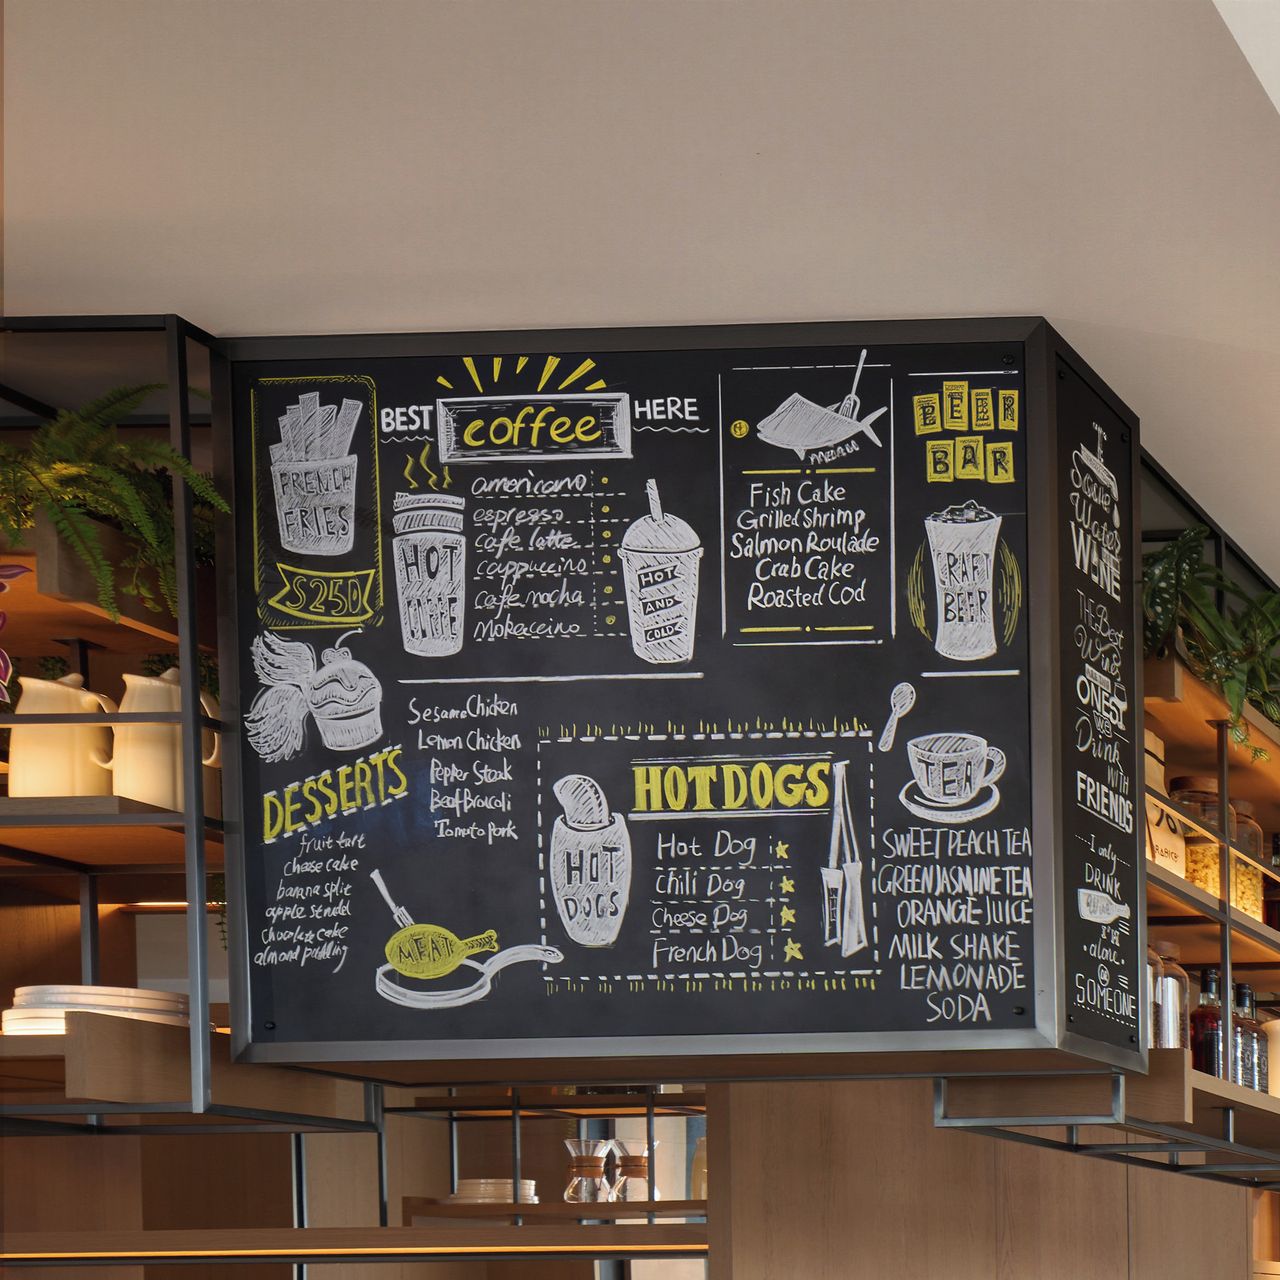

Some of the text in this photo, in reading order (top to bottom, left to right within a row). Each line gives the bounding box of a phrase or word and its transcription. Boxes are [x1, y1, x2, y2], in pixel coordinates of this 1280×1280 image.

[380, 397, 699, 447] BEST coffee HERE
[931, 445, 1010, 476] BAR
[471, 469, 587, 495] americano
[750, 478, 846, 507] Fish Cake
[283, 505, 350, 540] FRIES
[473, 507, 564, 533] espresso
[736, 506, 866, 534] Grilled Shrimp
[730, 528, 880, 559] Salmon Roulade
[402, 544, 458, 582] HOT
[640, 567, 674, 586] HOT
[755, 554, 855, 581] Crab Cake
[937, 552, 990, 587] CRAFT
[645, 598, 674, 614] AND
[747, 578, 867, 611] Roasted Cod
[944, 590, 990, 623] BEER
[646, 625, 675, 641] COLD
[408, 693, 518, 725] Sesame Chicken
[418, 728, 522, 752] Lemon Chicken
[430, 757, 469, 786] Pepper
[632, 762, 830, 811] HOT DOGS
[917, 758, 974, 798] TEA
[263, 750, 407, 840] DESSERTS
[1077, 770, 1133, 834] FRIENDS
[299, 834, 333, 857] fruit
[658, 830, 756, 866] Hot Dog
[882, 826, 1032, 859] SWEET PEACH TEA
[565, 845, 621, 886] HOT
[878, 863, 1033, 899] GREEN JASMINE TEA
[1085, 862, 1122, 900] DRINK
[656, 869, 745, 899] Chili Dog
[652, 904, 748, 929] Cheese Dog
[897, 897, 1033, 929] ORANGE JUICE
[399, 936, 454, 965] MEAT
[653, 935, 762, 969] French Dog
[888, 931, 1020, 961] MILK SHAKE
[900, 962, 1026, 993] LEMONADE
[926, 992, 992, 1023] SODA
[1076, 973, 1136, 1019] SOMEONE
